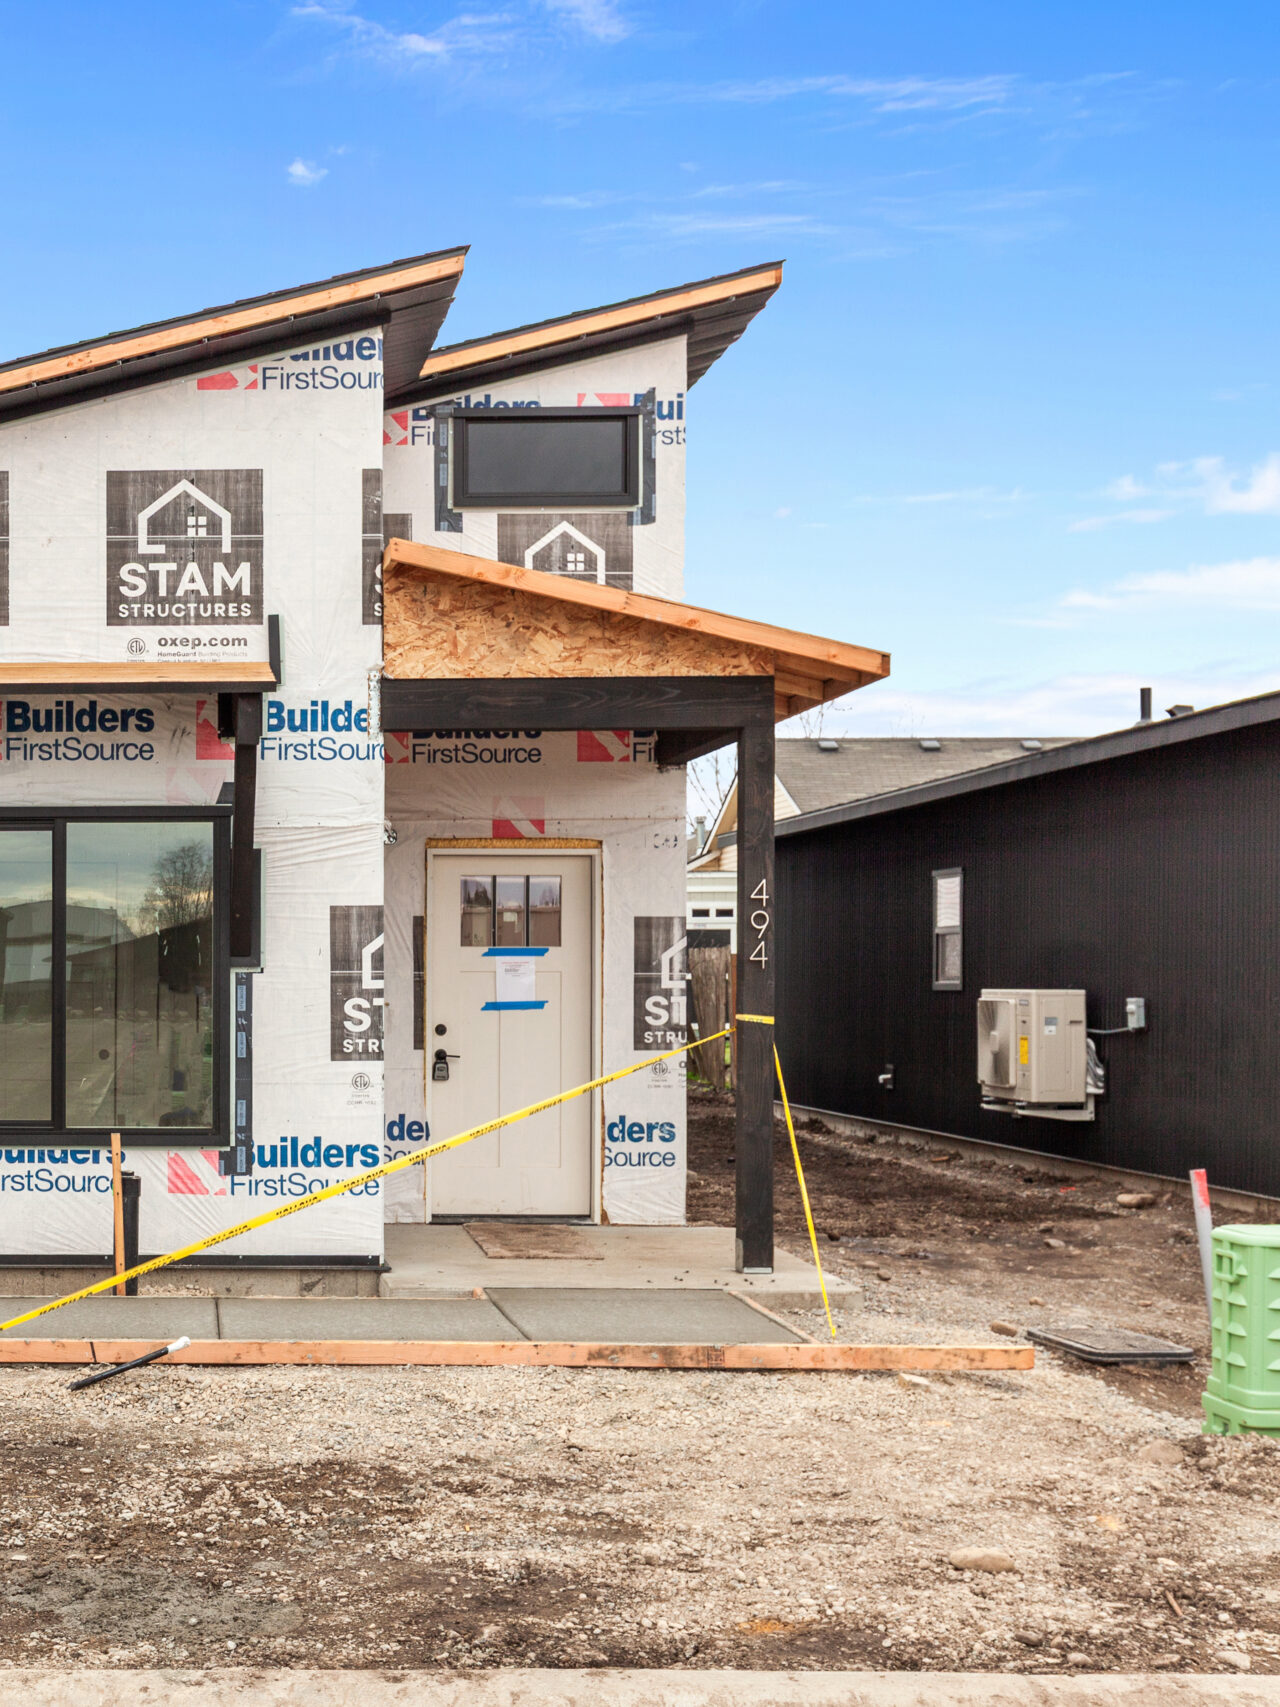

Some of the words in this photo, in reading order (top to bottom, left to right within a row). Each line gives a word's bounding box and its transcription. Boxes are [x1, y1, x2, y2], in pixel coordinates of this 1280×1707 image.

[262, 366, 384, 390] FirstSour
[118, 562, 252, 598] STAM
[118, 602, 252, 618] STRUCTURES
[158, 636, 248, 650] oxep.com
[5, 700, 155, 732] Builders
[6, 737, 154, 761] FirstSource
[412, 743, 543, 764] FirstSource
[343, 1039, 384, 1053] STR
[251, 1136, 380, 1168] uilders
[231, 1172, 380, 1197] FirstSoce
